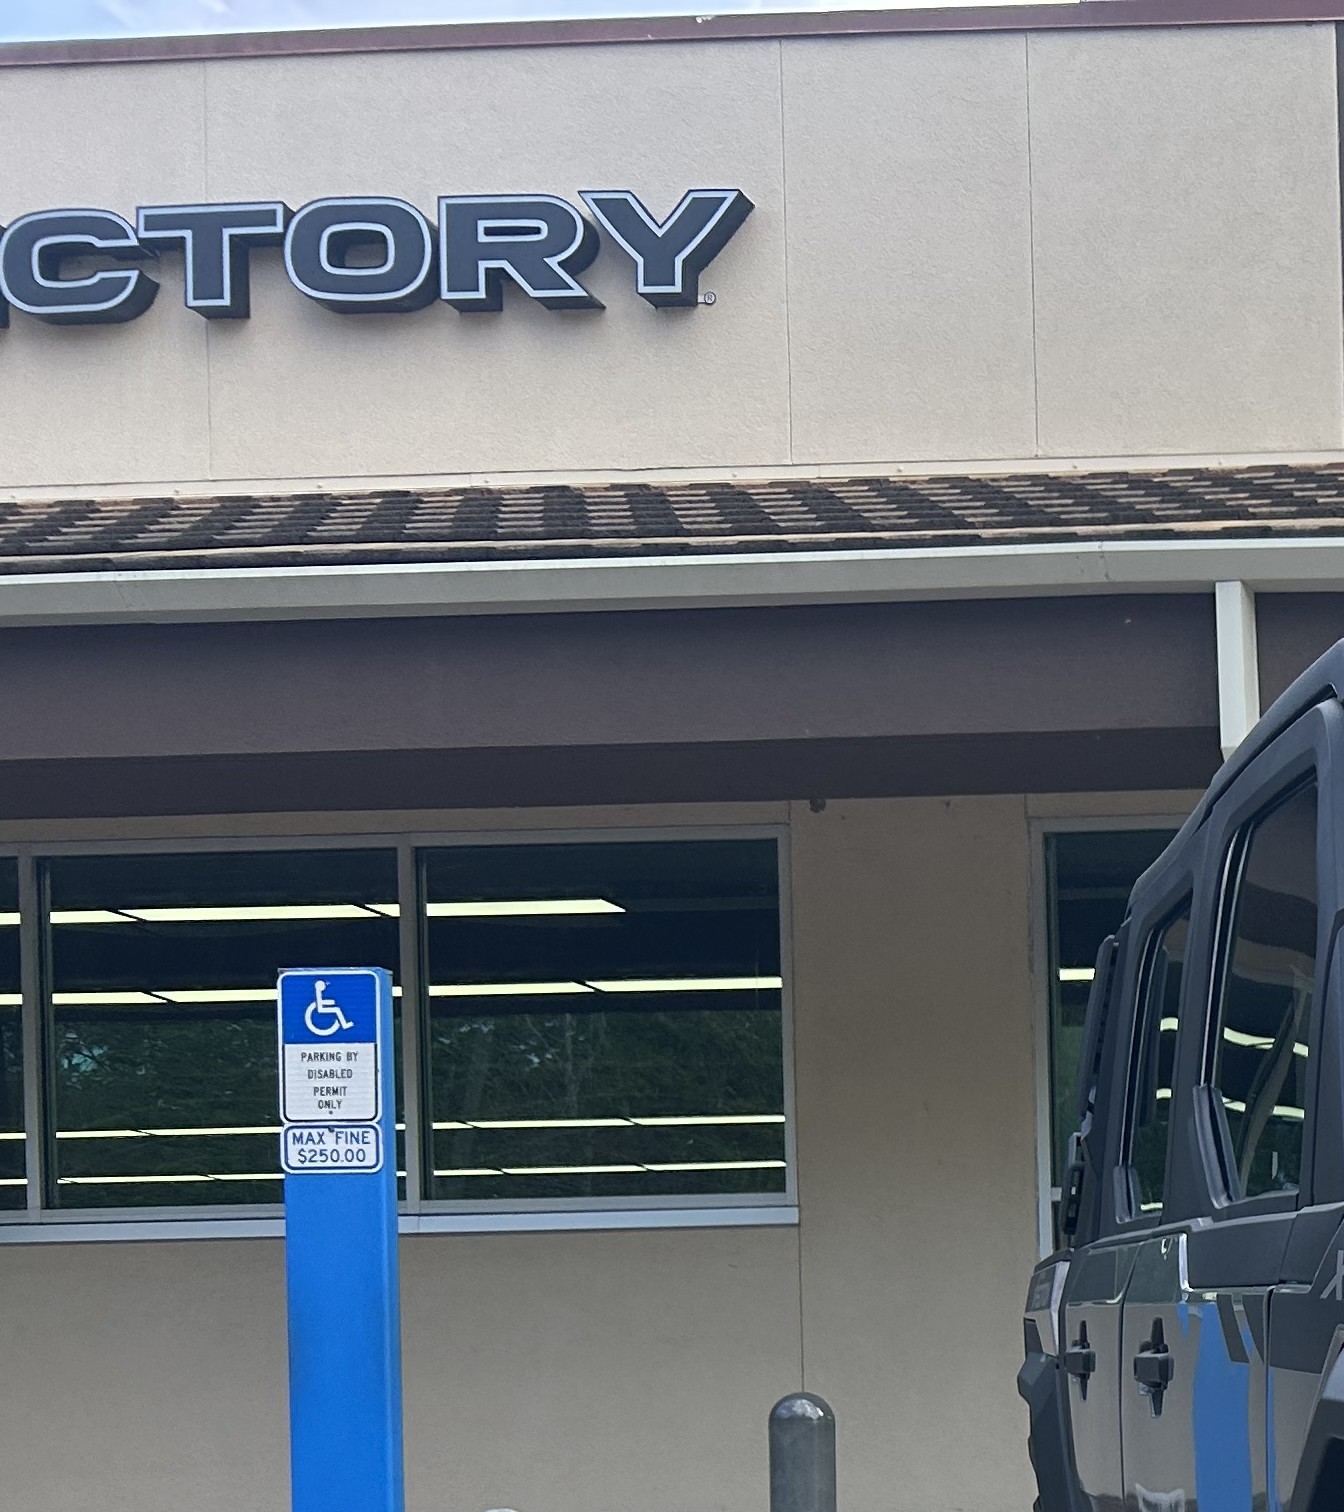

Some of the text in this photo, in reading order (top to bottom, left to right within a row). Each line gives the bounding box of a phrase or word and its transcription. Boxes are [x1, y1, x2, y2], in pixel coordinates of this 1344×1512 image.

[0, 188, 755, 325] CTORY
[301, 1051, 359, 1062] PARKING BY
[307, 1069, 353, 1079] DISABLED
[313, 1086, 348, 1096] PERMIT
[317, 1100, 342, 1110] ONLY
[292, 1131, 371, 1145] MAX FINE
[297, 1148, 366, 1165] $250.00
